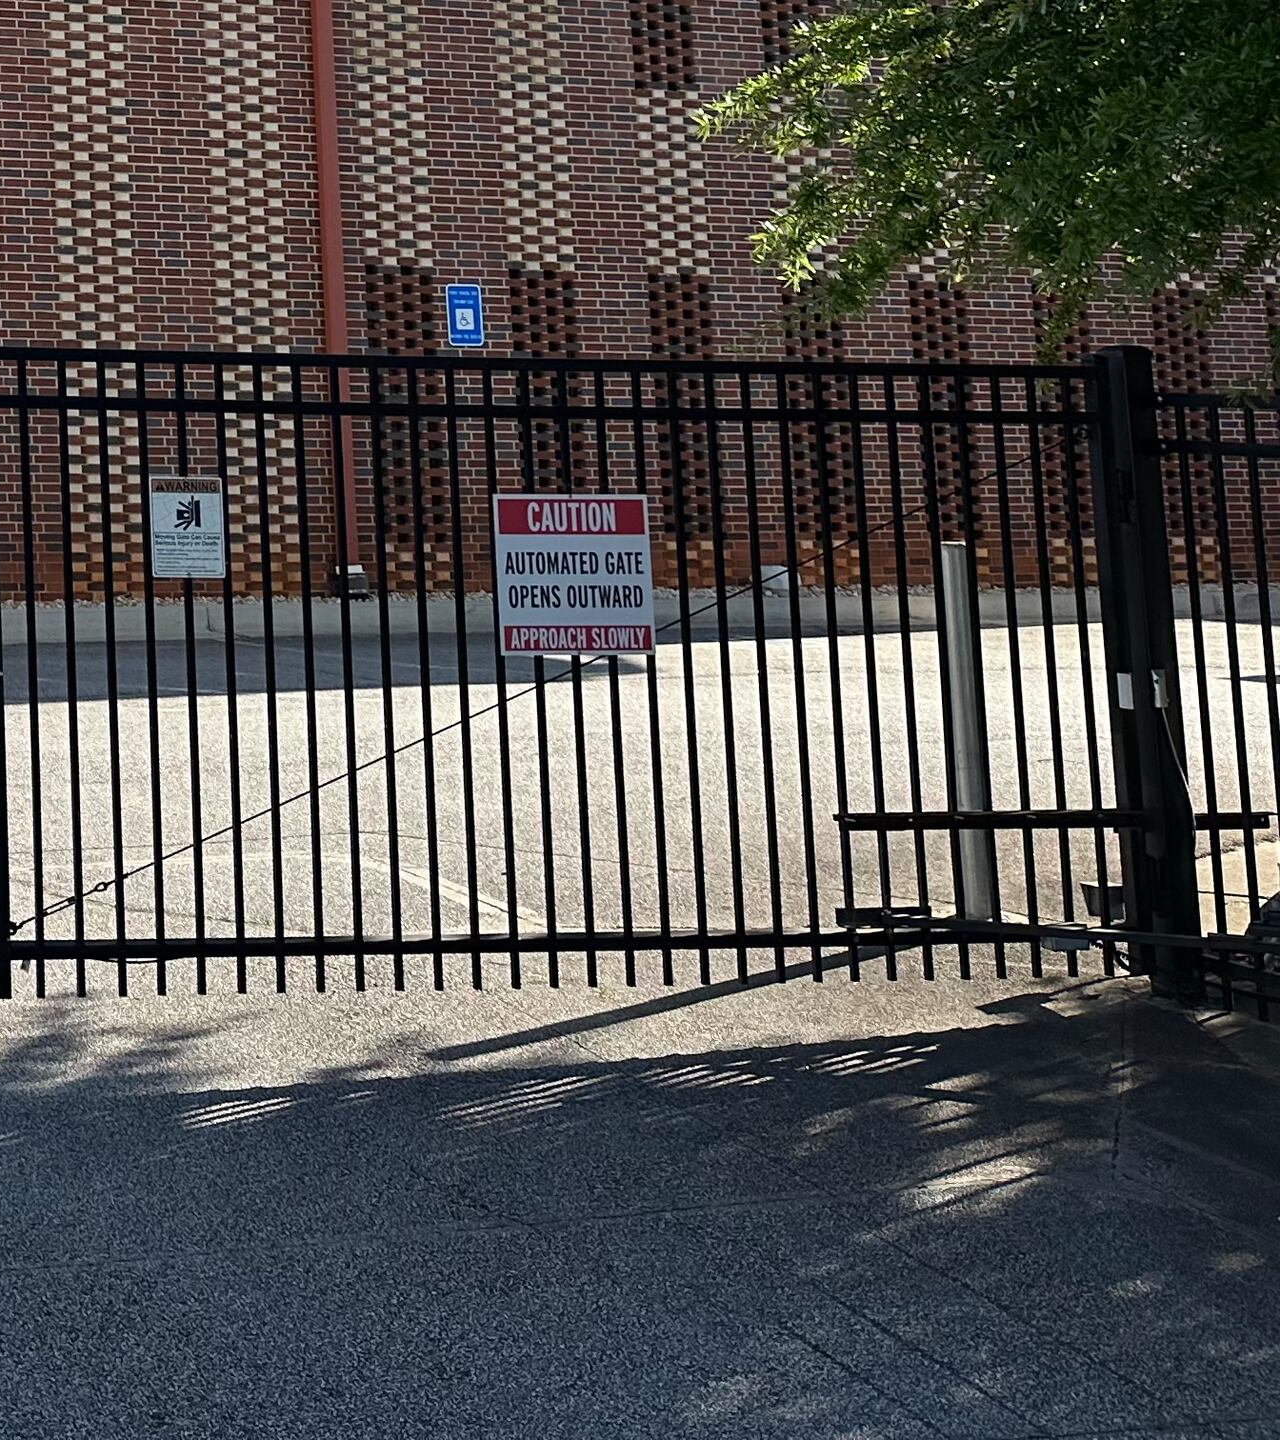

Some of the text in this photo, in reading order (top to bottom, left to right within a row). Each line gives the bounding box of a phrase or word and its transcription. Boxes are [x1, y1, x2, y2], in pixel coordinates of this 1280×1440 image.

[164, 481, 217, 491] WARNING
[527, 501, 616, 532] CAUTION
[505, 551, 644, 575] AUTOMATED GATE
[508, 585, 643, 608] OPENS OUTWARD
[511, 627, 646, 649] APPROACH SLOWLY
